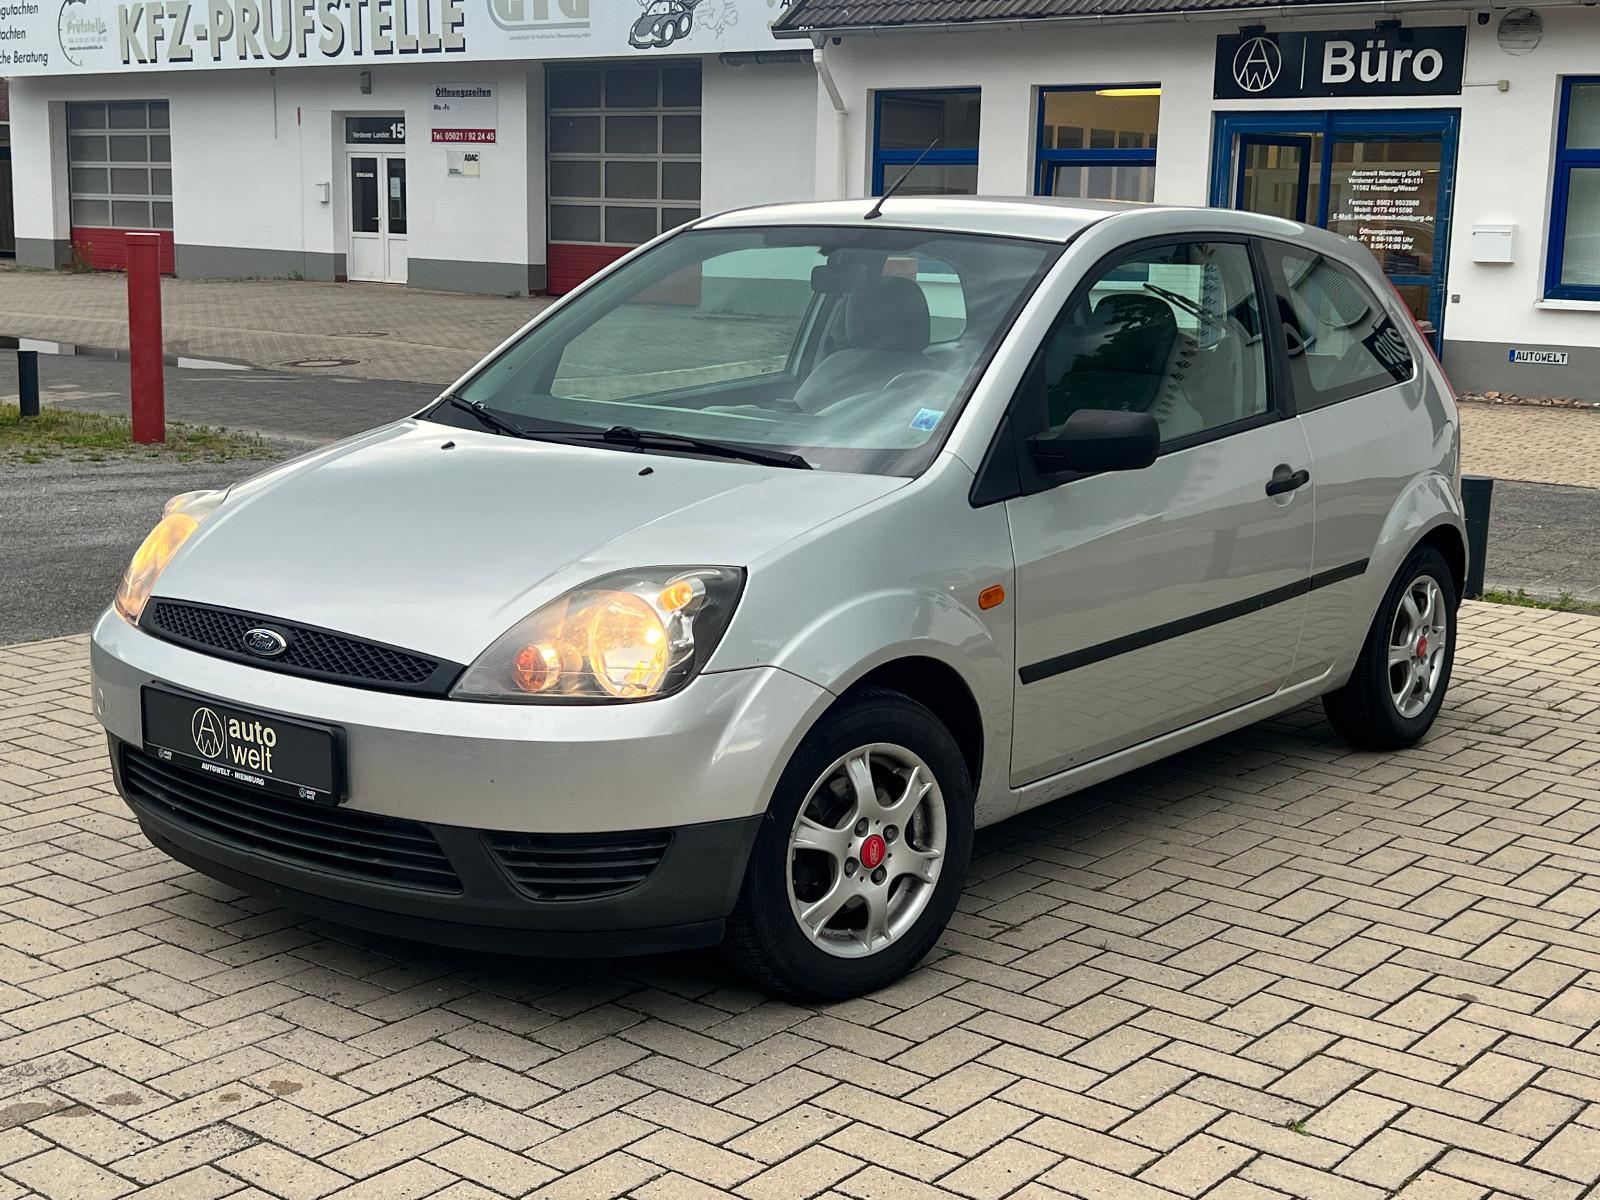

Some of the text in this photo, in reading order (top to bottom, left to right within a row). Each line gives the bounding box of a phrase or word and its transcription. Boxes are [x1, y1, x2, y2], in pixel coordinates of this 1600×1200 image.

[13, 50, 49, 67] Beratung
[1321, 39, 1443, 84] Büro
[435, 86, 492, 98] Öffnungszeiten
[433, 131, 444, 141] Tel.
[445, 131, 463, 141] 05021
[468, 131, 477, 141] 92
[477, 131, 486, 141] 24
[486, 131, 495, 141] 45
[464, 153, 479, 162] ADAC
[1379, 170, 1406, 178] Nienburg
[1370, 184, 1419, 193] Nienburg/Weser
[1515, 351, 1567, 364] AUTOWELT
[249, 632, 274, 651] Ford
[229, 717, 277, 748] auto
[232, 743, 273, 774] welt
[201, 762, 231, 777] AUTOWELT
[234, 771, 266, 786] NIENBURG
